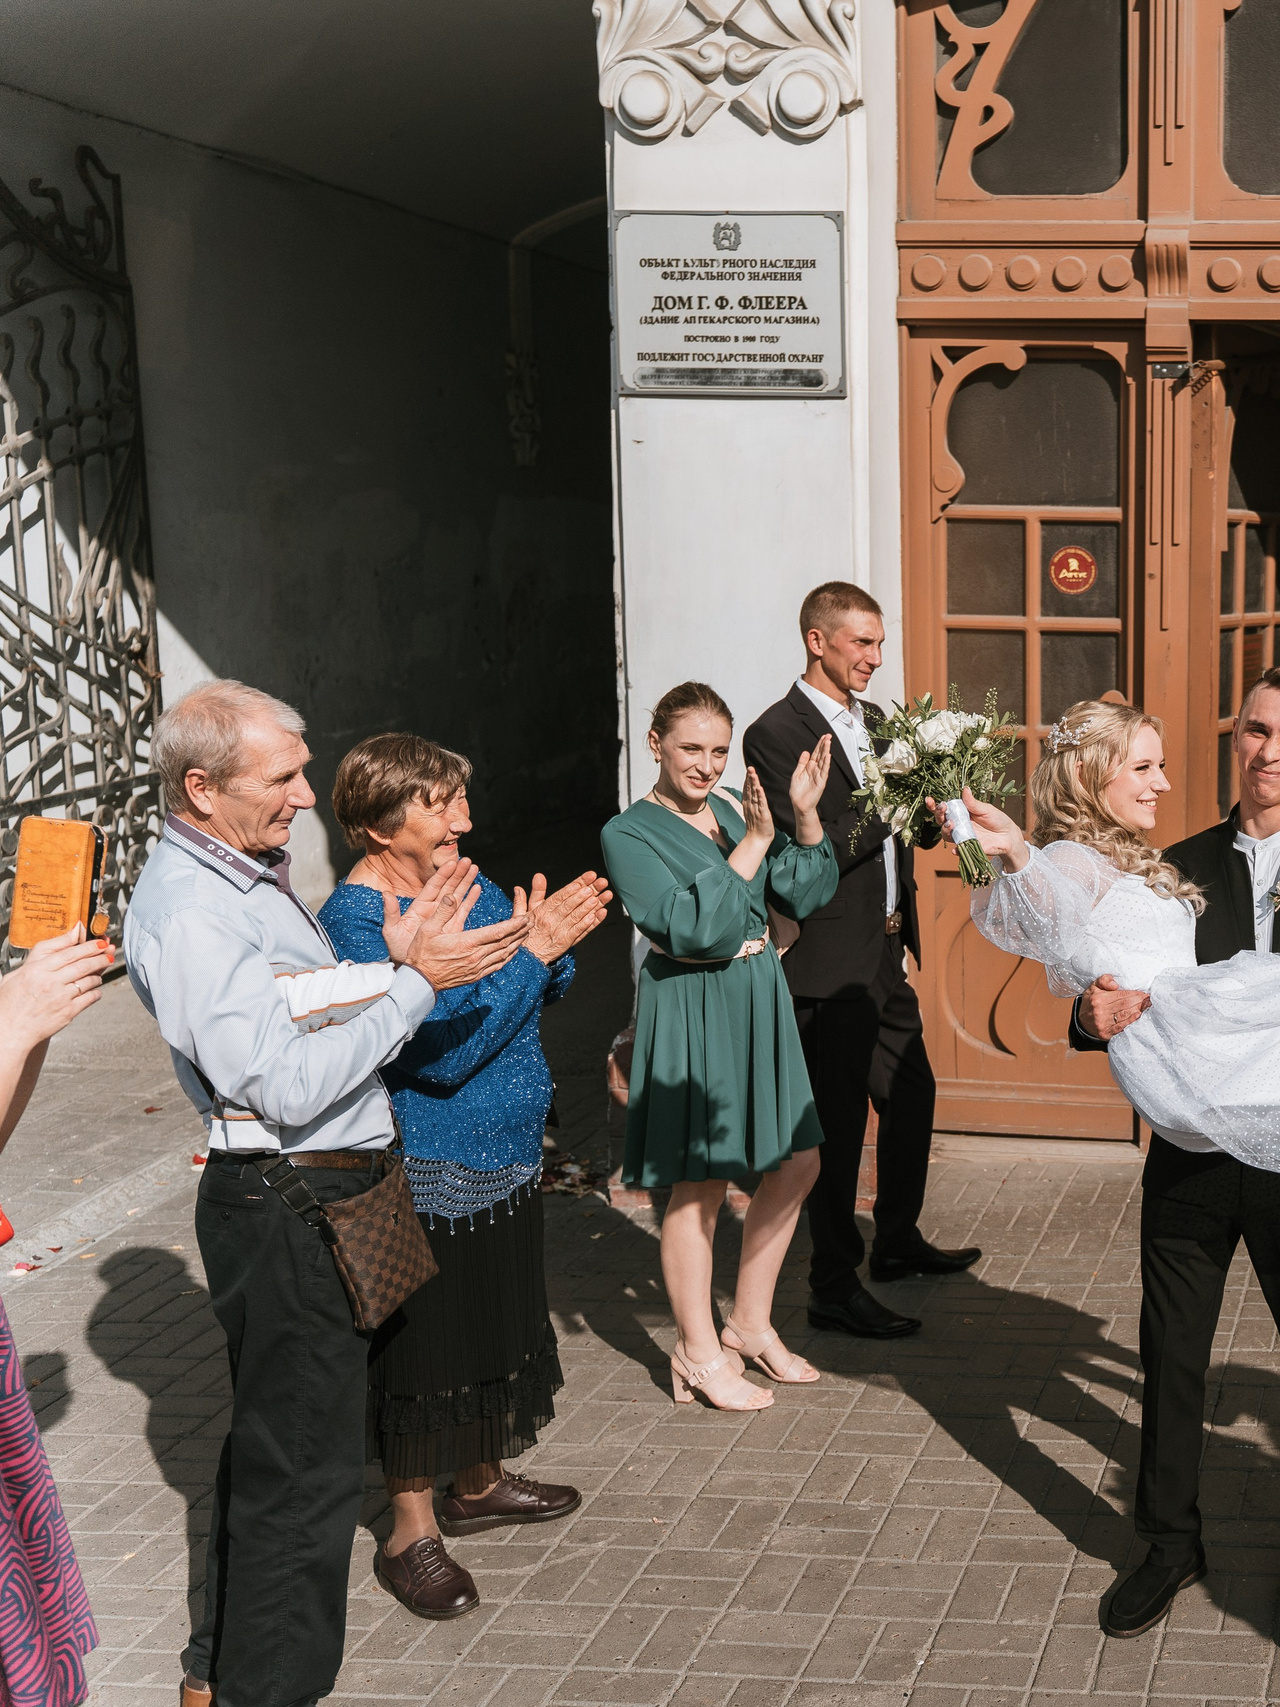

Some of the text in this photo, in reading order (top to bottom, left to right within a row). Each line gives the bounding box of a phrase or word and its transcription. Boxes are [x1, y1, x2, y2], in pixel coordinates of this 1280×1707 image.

[760, 259, 816, 269] НАСЛЕДИЯ
[661, 271, 802, 281] ФЕДЕРАЛЬНОГО ЗНАЧЕНИЯ
[651, 296, 808, 313] ДОМ Г. Ф. ФЛЕЕРА
[639, 316, 820, 326] (ЗДАНИЕ АПТЕКАРСКОГО МАГАЗИНА)
[684, 335, 731, 343] ПОСТРОЕНО
[734, 335, 740, 343] В
[760, 335, 781, 344] ГОДУ
[637, 352, 690, 362] ПОДЛЕЖИТ
